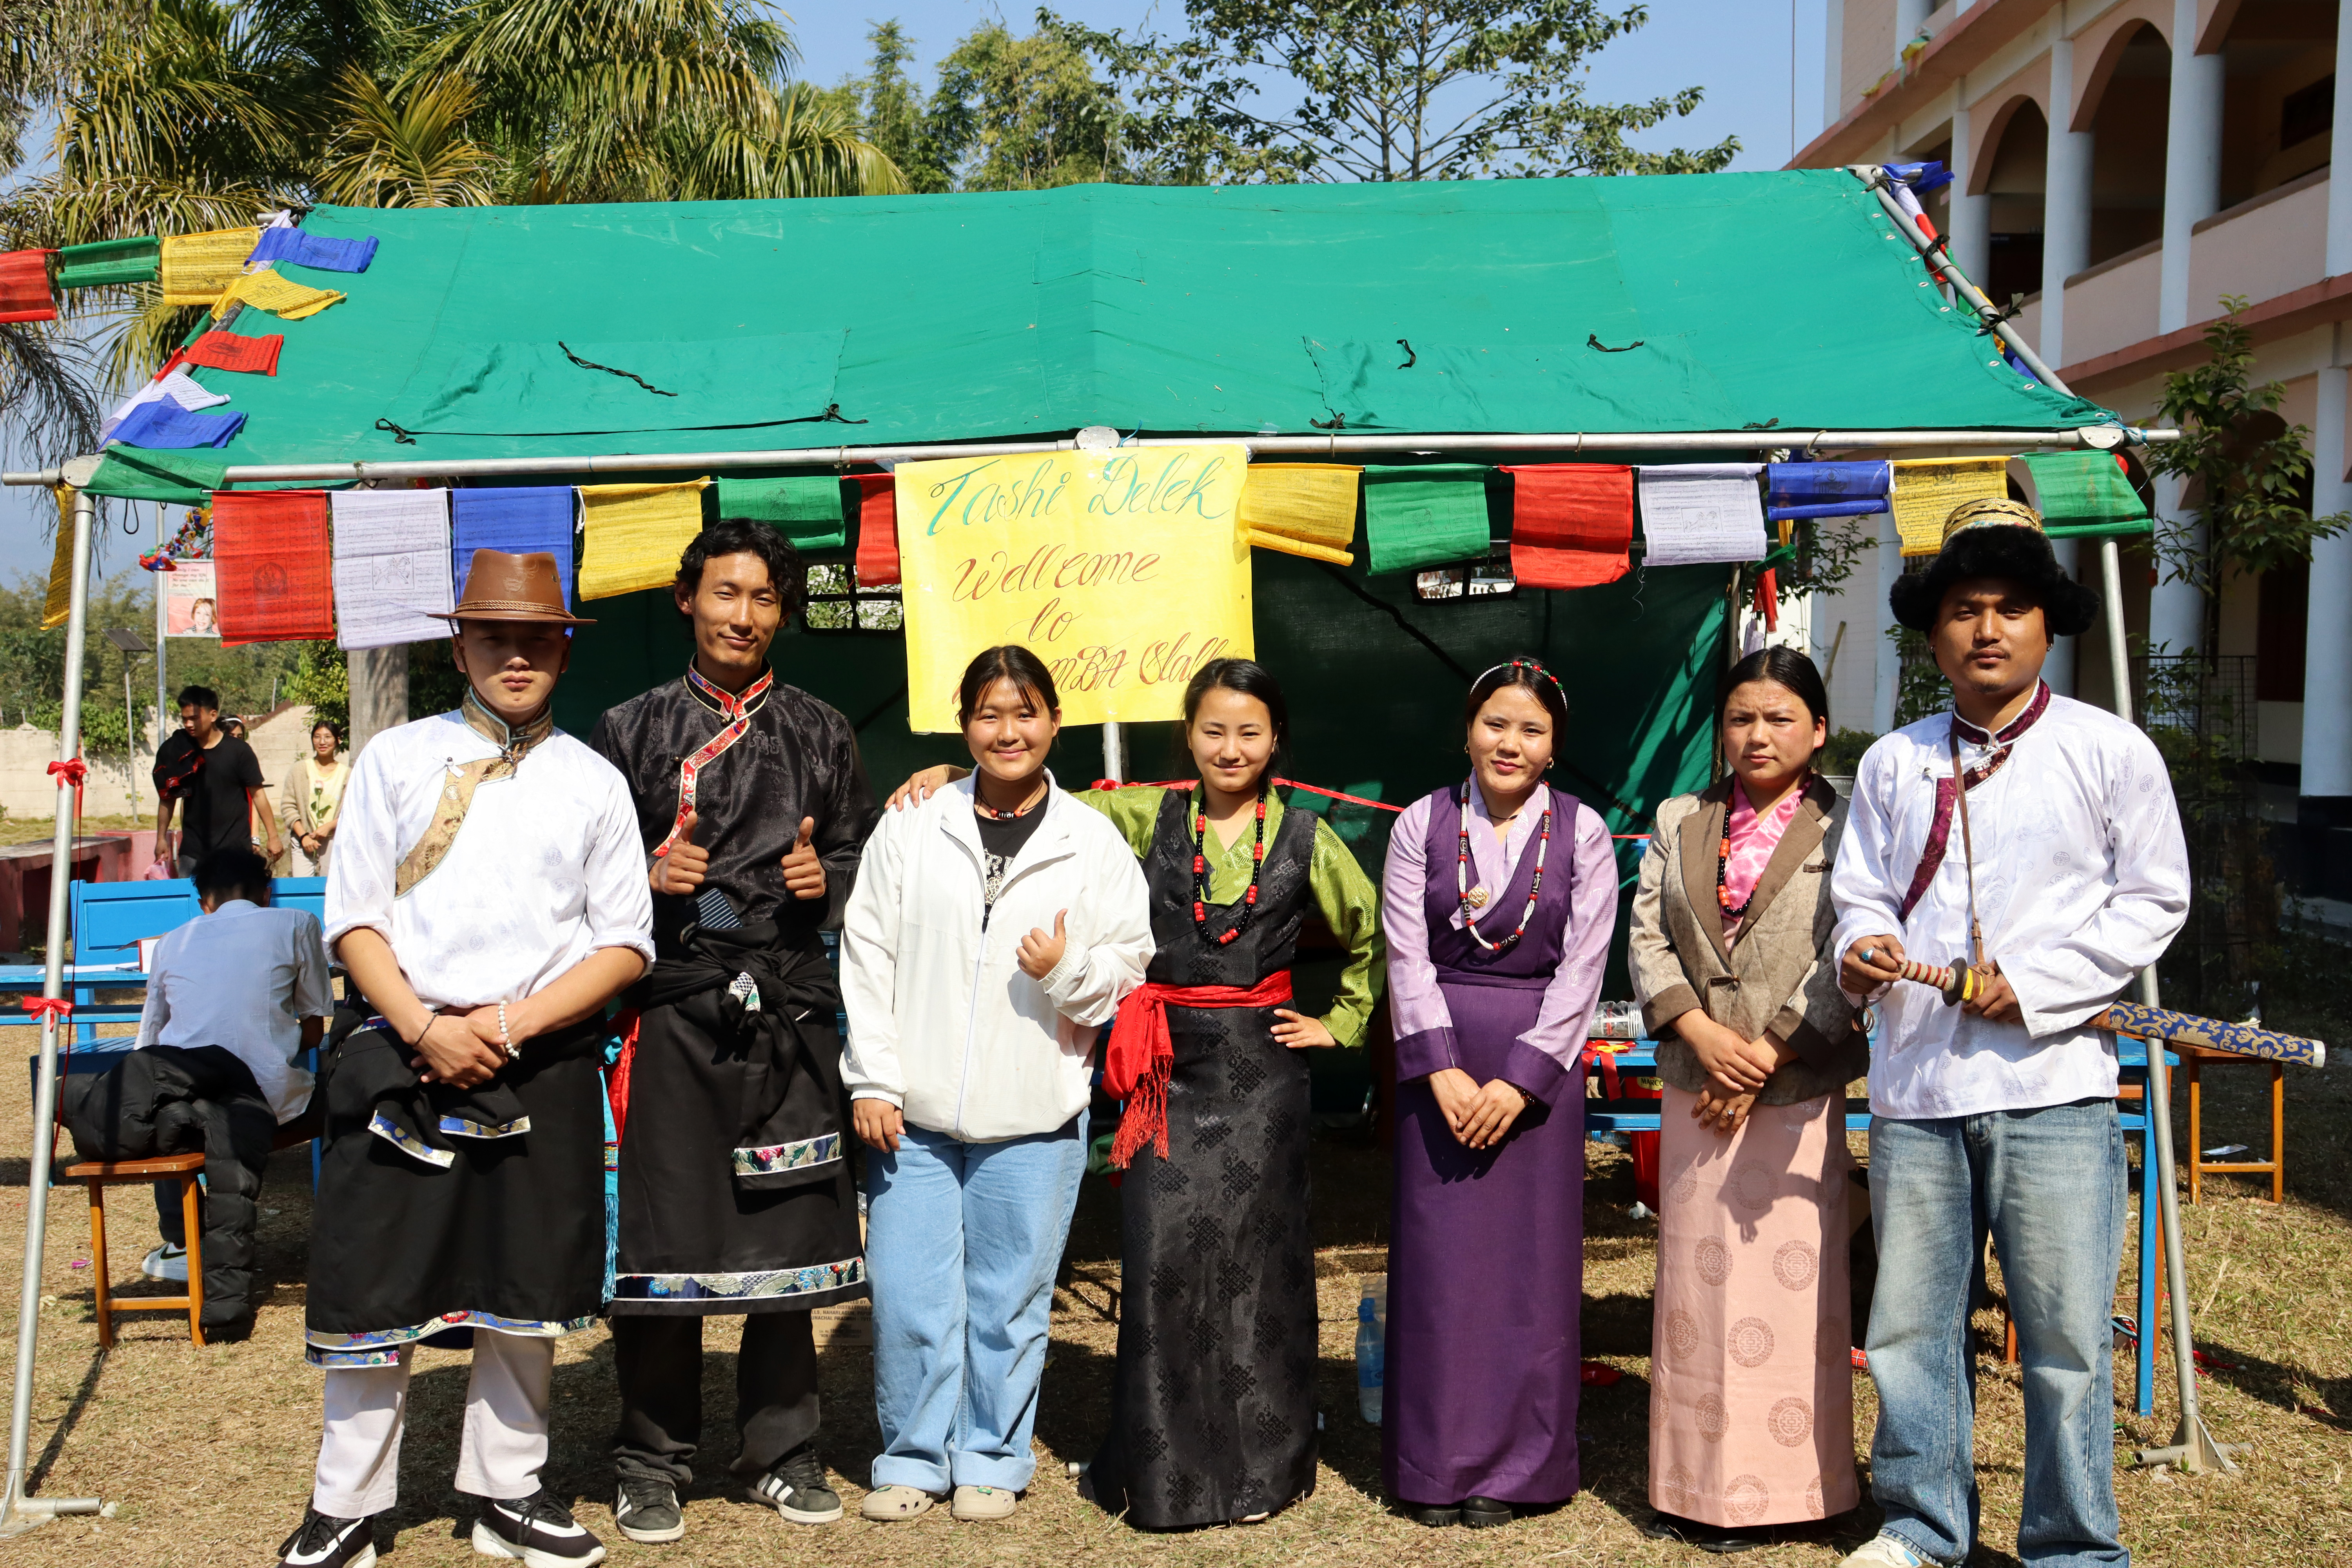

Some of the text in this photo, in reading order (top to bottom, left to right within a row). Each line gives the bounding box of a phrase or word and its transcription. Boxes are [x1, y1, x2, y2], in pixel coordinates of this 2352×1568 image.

[927, 459, 1071, 536] Tashi
[1087, 452, 1231, 519] Delek
[1006, 597, 1083, 642] to
